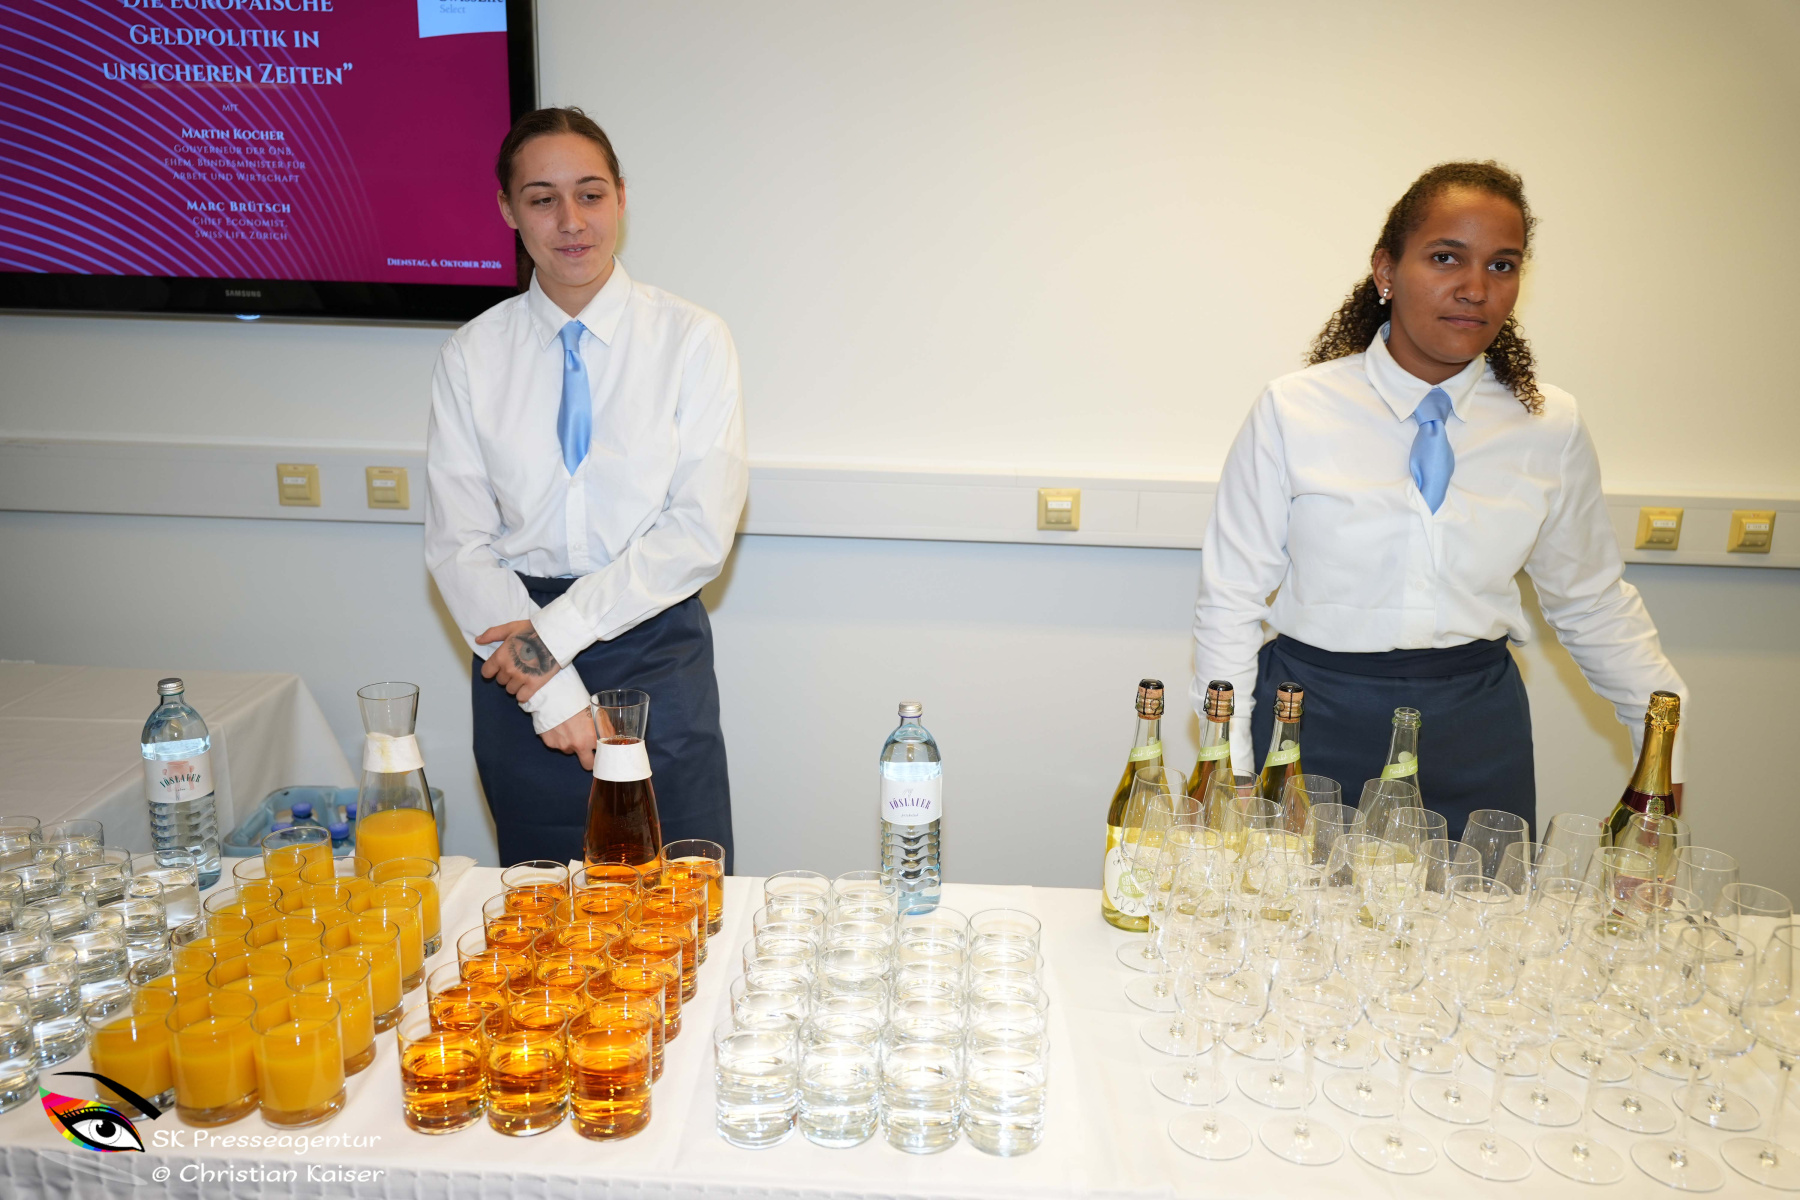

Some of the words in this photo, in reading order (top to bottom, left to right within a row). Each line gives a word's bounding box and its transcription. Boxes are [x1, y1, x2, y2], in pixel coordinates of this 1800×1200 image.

[440, 4, 466, 13] Select
[129, 24, 288, 47] GELDPOLITIK
[293, 30, 320, 48] IN
[102, 62, 252, 83] UNSICHEREN
[221, 103, 239, 112] MIT
[181, 127, 231, 140] MARTIN
[233, 128, 285, 141] KOCHER
[173, 144, 243, 155] GOUVERNEUR
[246, 146, 266, 156] DER
[197, 158, 284, 170] BUNDESMINISTER
[287, 159, 307, 170] FÜR
[173, 171, 208, 182] ARBEIT
[210, 172, 234, 182] UND
[236, 171, 301, 184] WIRTSCHAFT
[186, 199, 226, 212] MARC
[230, 200, 292, 214] BRÜTSCH
[192, 216, 222, 226] CHIEF
[195, 230, 223, 239] SWISS
[225, 230, 247, 240] LIFE
[249, 230, 289, 241] ZÜRICH
[387, 257, 431, 268] DIENSTAG,
[440, 258, 480, 269] OKTOBER
[225, 289, 262, 298] SAMSUNG
[160, 773, 201, 788] VÖSLAUER
[889, 797, 931, 810] VÖSLAUER
